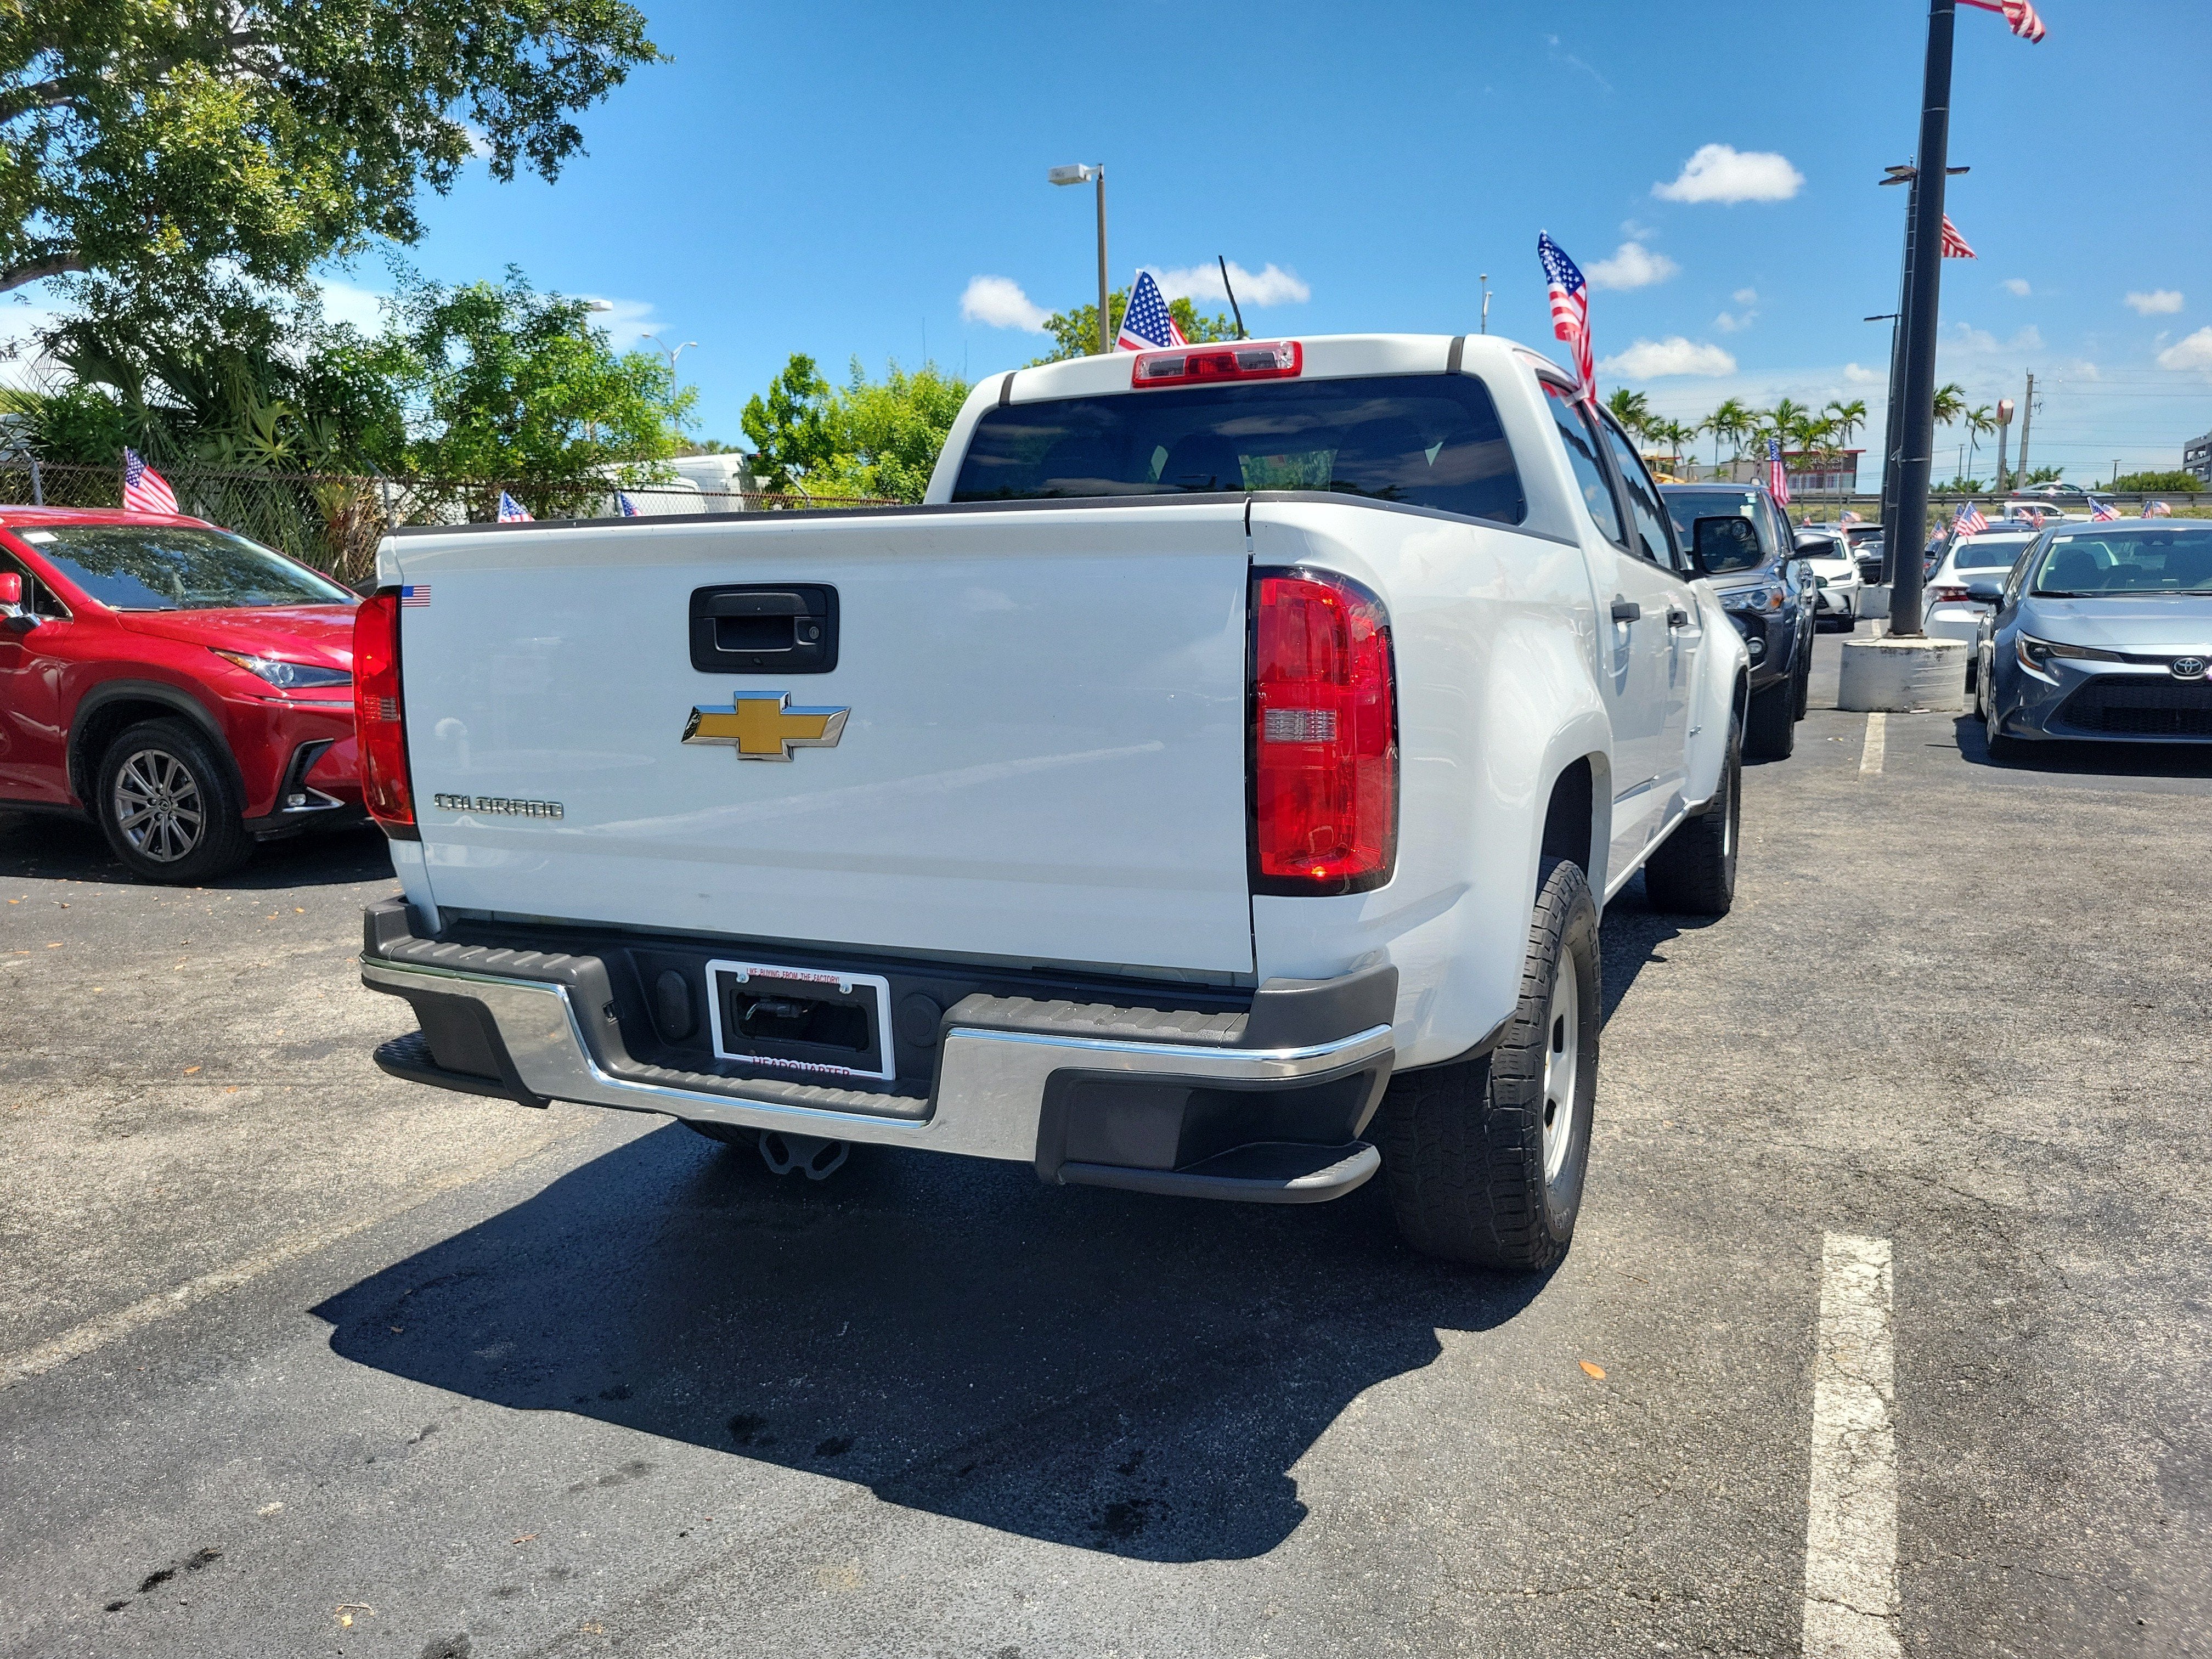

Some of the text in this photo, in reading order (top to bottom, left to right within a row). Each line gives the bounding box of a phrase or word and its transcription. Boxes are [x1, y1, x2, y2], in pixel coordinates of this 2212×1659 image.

[434, 793, 564, 820] COLORADO
[760, 968, 780, 978] BUYING
[783, 971, 798, 980] FROM
[801, 973, 811, 981] THE
[814, 974, 840, 984] FACTORY!
